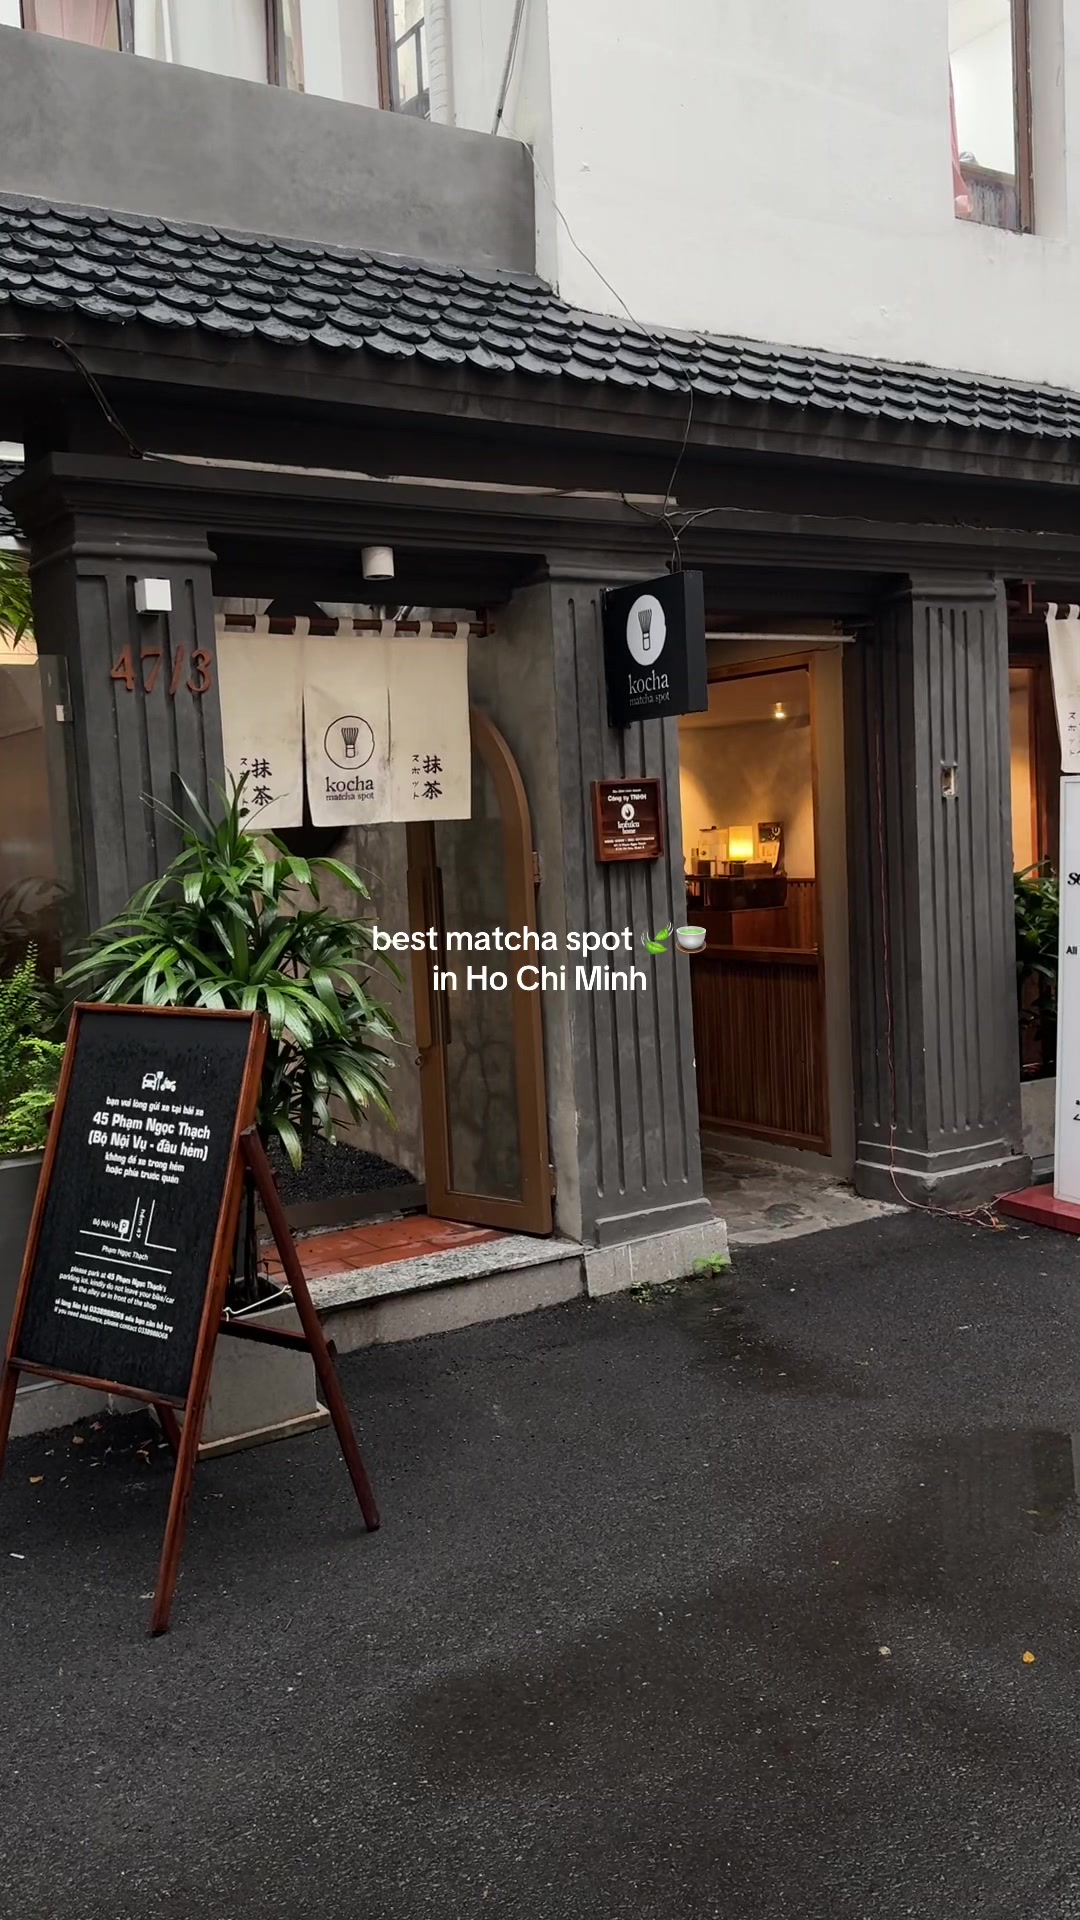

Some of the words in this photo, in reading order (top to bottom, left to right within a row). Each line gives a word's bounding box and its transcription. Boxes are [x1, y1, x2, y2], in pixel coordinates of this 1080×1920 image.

[110, 643, 212, 694] 47/3
[628, 669, 669, 694] kocha
[629, 694, 654, 706] matcha
[655, 692, 670, 704] spot
[251, 758, 273, 806] 抹茶
[325, 776, 374, 792] kocha
[421, 755, 443, 799] 抹茶
[325, 792, 355, 801] matcha
[357, 792, 374, 801] spot
[1066, 946, 1078, 955] All
[161, 1104, 170, 1112] xe
[195, 1108, 204, 1117] xe
[93, 1111, 110, 1126] 45
[111, 1113, 143, 1131] Phạm
[146, 1117, 175, 1136] Ngọc
[178, 1121, 211, 1140] Thạch
[88, 1130, 108, 1147] (Bộ
[110, 1132, 130, 1149] Nội
[132, 1135, 148, 1152] Vụ
[156, 1138, 178, 1154] đầu
[180, 1142, 209, 1161] hẻm)
[147, 1158, 168, 1172] trong
[70, 1266, 88, 1275] please
[87, 1269, 100, 1278] park
[106, 1272, 115, 1281] 45
[59, 1272, 80, 1284] parking
[90, 1278, 106, 1289] kindly
[106, 1282, 114, 1290] do
[124, 1285, 138, 1296] leave
[138, 1290, 152, 1299] your
[151, 1292, 175, 1304] bike/car
[78, 1285, 88, 1294] the
[87, 1288, 101, 1298] alley
[107, 1292, 113, 1300] in
[113, 1293, 127, 1303] front
[133, 1298, 143, 1307] the
[143, 1301, 158, 1311] shop
[67, 1310, 80, 1318] need
[119, 1323, 138, 1332] contact
